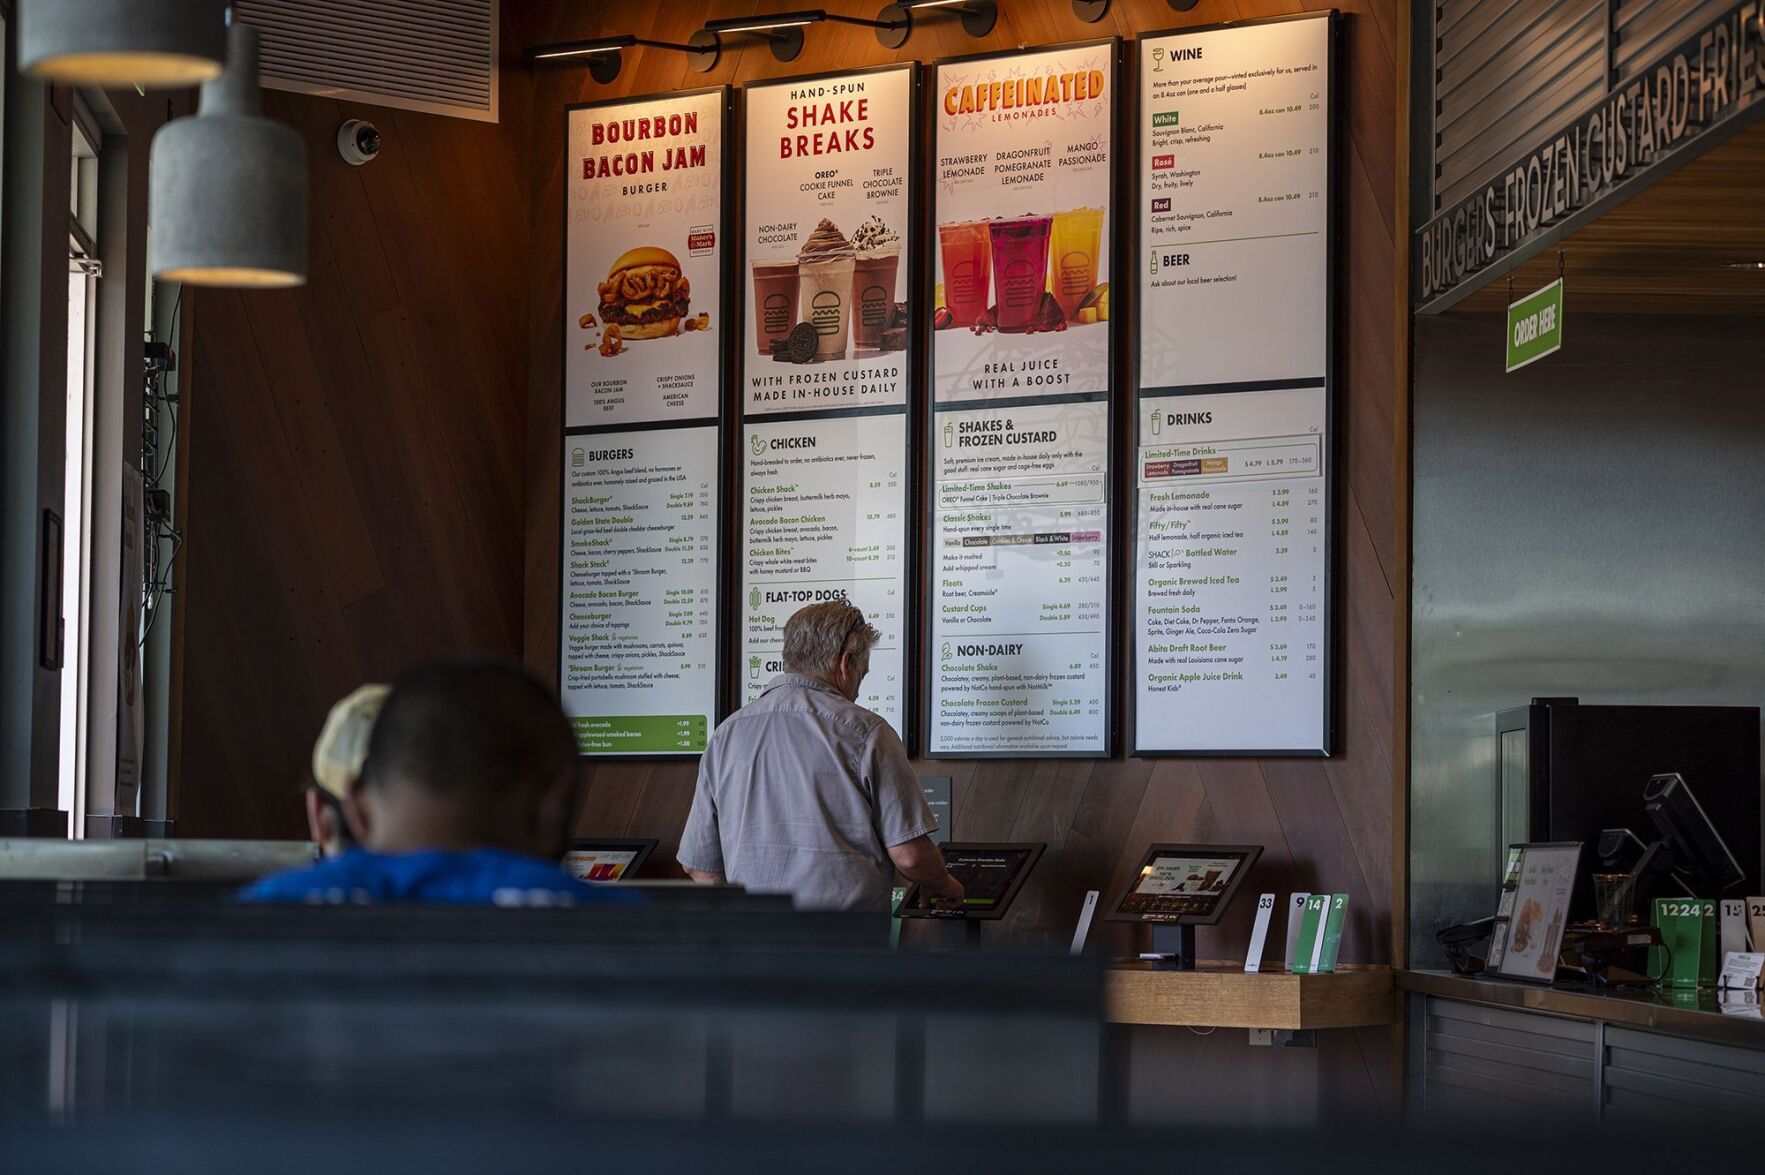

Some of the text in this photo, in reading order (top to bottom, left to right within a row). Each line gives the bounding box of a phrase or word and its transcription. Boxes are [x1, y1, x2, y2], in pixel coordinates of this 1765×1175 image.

[1170, 48, 1202, 62] WINE
[1180, 79, 1191, 87] your
[1193, 77, 1214, 85] average
[1248, 69, 1275, 78] exclusively
[791, 83, 865, 100] HAND-SPUN
[945, 70, 1105, 116] CAFFEINATED
[787, 99, 868, 129] SHAKE
[992, 108, 1056, 122] LEMONADES
[1154, 114, 1176, 124] White
[592, 112, 697, 145] BOURBON
[1152, 128, 1180, 137] Sauvignon
[1198, 124, 1223, 132] California
[781, 127, 874, 159] BREAKS
[1067, 142, 1098, 153] MANGO
[997, 147, 1050, 160] DRAGONFRUIT
[583, 145, 705, 179] BACON JAM
[941, 154, 987, 166] STRAWBERRY
[995, 159, 1051, 173] POMEGRANATE
[1059, 154, 1106, 166] PASSIONADE
[1154, 158, 1172, 166] Rosé
[873, 168, 892, 176] TRIPLE
[943, 167, 985, 178] LEMONADE
[1170, 170, 1200, 179] Washington
[1423, 187, 1495, 298] BURGERS
[1505, 126, 1579, 246] FROZEN
[1586, 54, 1689, 193] CUSTARD
[863, 178, 903, 188] CHOCOLATE
[1002, 173, 1044, 185] LEMONADE
[623, 182, 667, 195] BURGER
[800, 179, 853, 192] COOKIE FUNNEL
[818, 192, 835, 200] CAKE
[867, 189, 899, 199] BROWNIE
[1154, 201, 1168, 209] Red
[1152, 215, 1175, 223] Cabernet
[1207, 209, 1232, 218] California
[759, 223, 797, 233] NON-DAIRY
[758, 233, 797, 244] CHOCOLATE
[1163, 254, 1190, 267] BEER
[1514, 304, 1556, 347] ORDER HERE
[985, 359, 1058, 374] REAL JUICE
[752, 368, 898, 387] WITH FROZEN CUSTARD
[973, 374, 1070, 390] WITH A BOOST
[754, 383, 897, 401] MADE IN-HOUSE DAILY
[1168, 412, 1212, 426] DRINKS
[959, 419, 1014, 433] SHAKES &
[771, 437, 816, 449] CHICKEN
[959, 431, 1057, 447] FROZEN CUSTARD
[589, 448, 633, 461] BURGERS
[1145, 447, 1216, 459] Limited-Time Drinks
[942, 482, 1011, 493] Limited-Time Shakes
[1172, 492, 1210, 500] Lemonade
[572, 518, 594, 526] Golden
[612, 516, 633, 524] Double
[751, 515, 825, 525] Avocado Bacon Chicken
[943, 513, 991, 523] Classic Shakes
[1149, 550, 1170, 558] SHACK
[1186, 549, 1212, 557] Bottled
[1148, 578, 1177, 588] Organic
[1179, 577, 1208, 585] Brewed
[1226, 576, 1239, 584] Tea
[766, 589, 846, 603] FLAT-TOP DOGS
[942, 604, 986, 613] Custard Cups
[1148, 606, 1180, 614] Fountain
[570, 612, 611, 622] Cheeseburger
[762, 616, 775, 624] Dog
[569, 634, 590, 643] Veggie
[957, 644, 1023, 656] NON-DAIRY
[1148, 645, 1168, 653] Abita
[1170, 644, 1188, 652] Draft
[942, 664, 975, 672] Chocolate
[1148, 672, 1243, 682] Organic Apple Juice Drink
[1001, 698, 1028, 706] Custard
[1260, 898, 1272, 908] 33
[1297, 897, 1305, 907] 9
[1308, 900, 1320, 910] 14
[1336, 898, 1343, 909] 2
